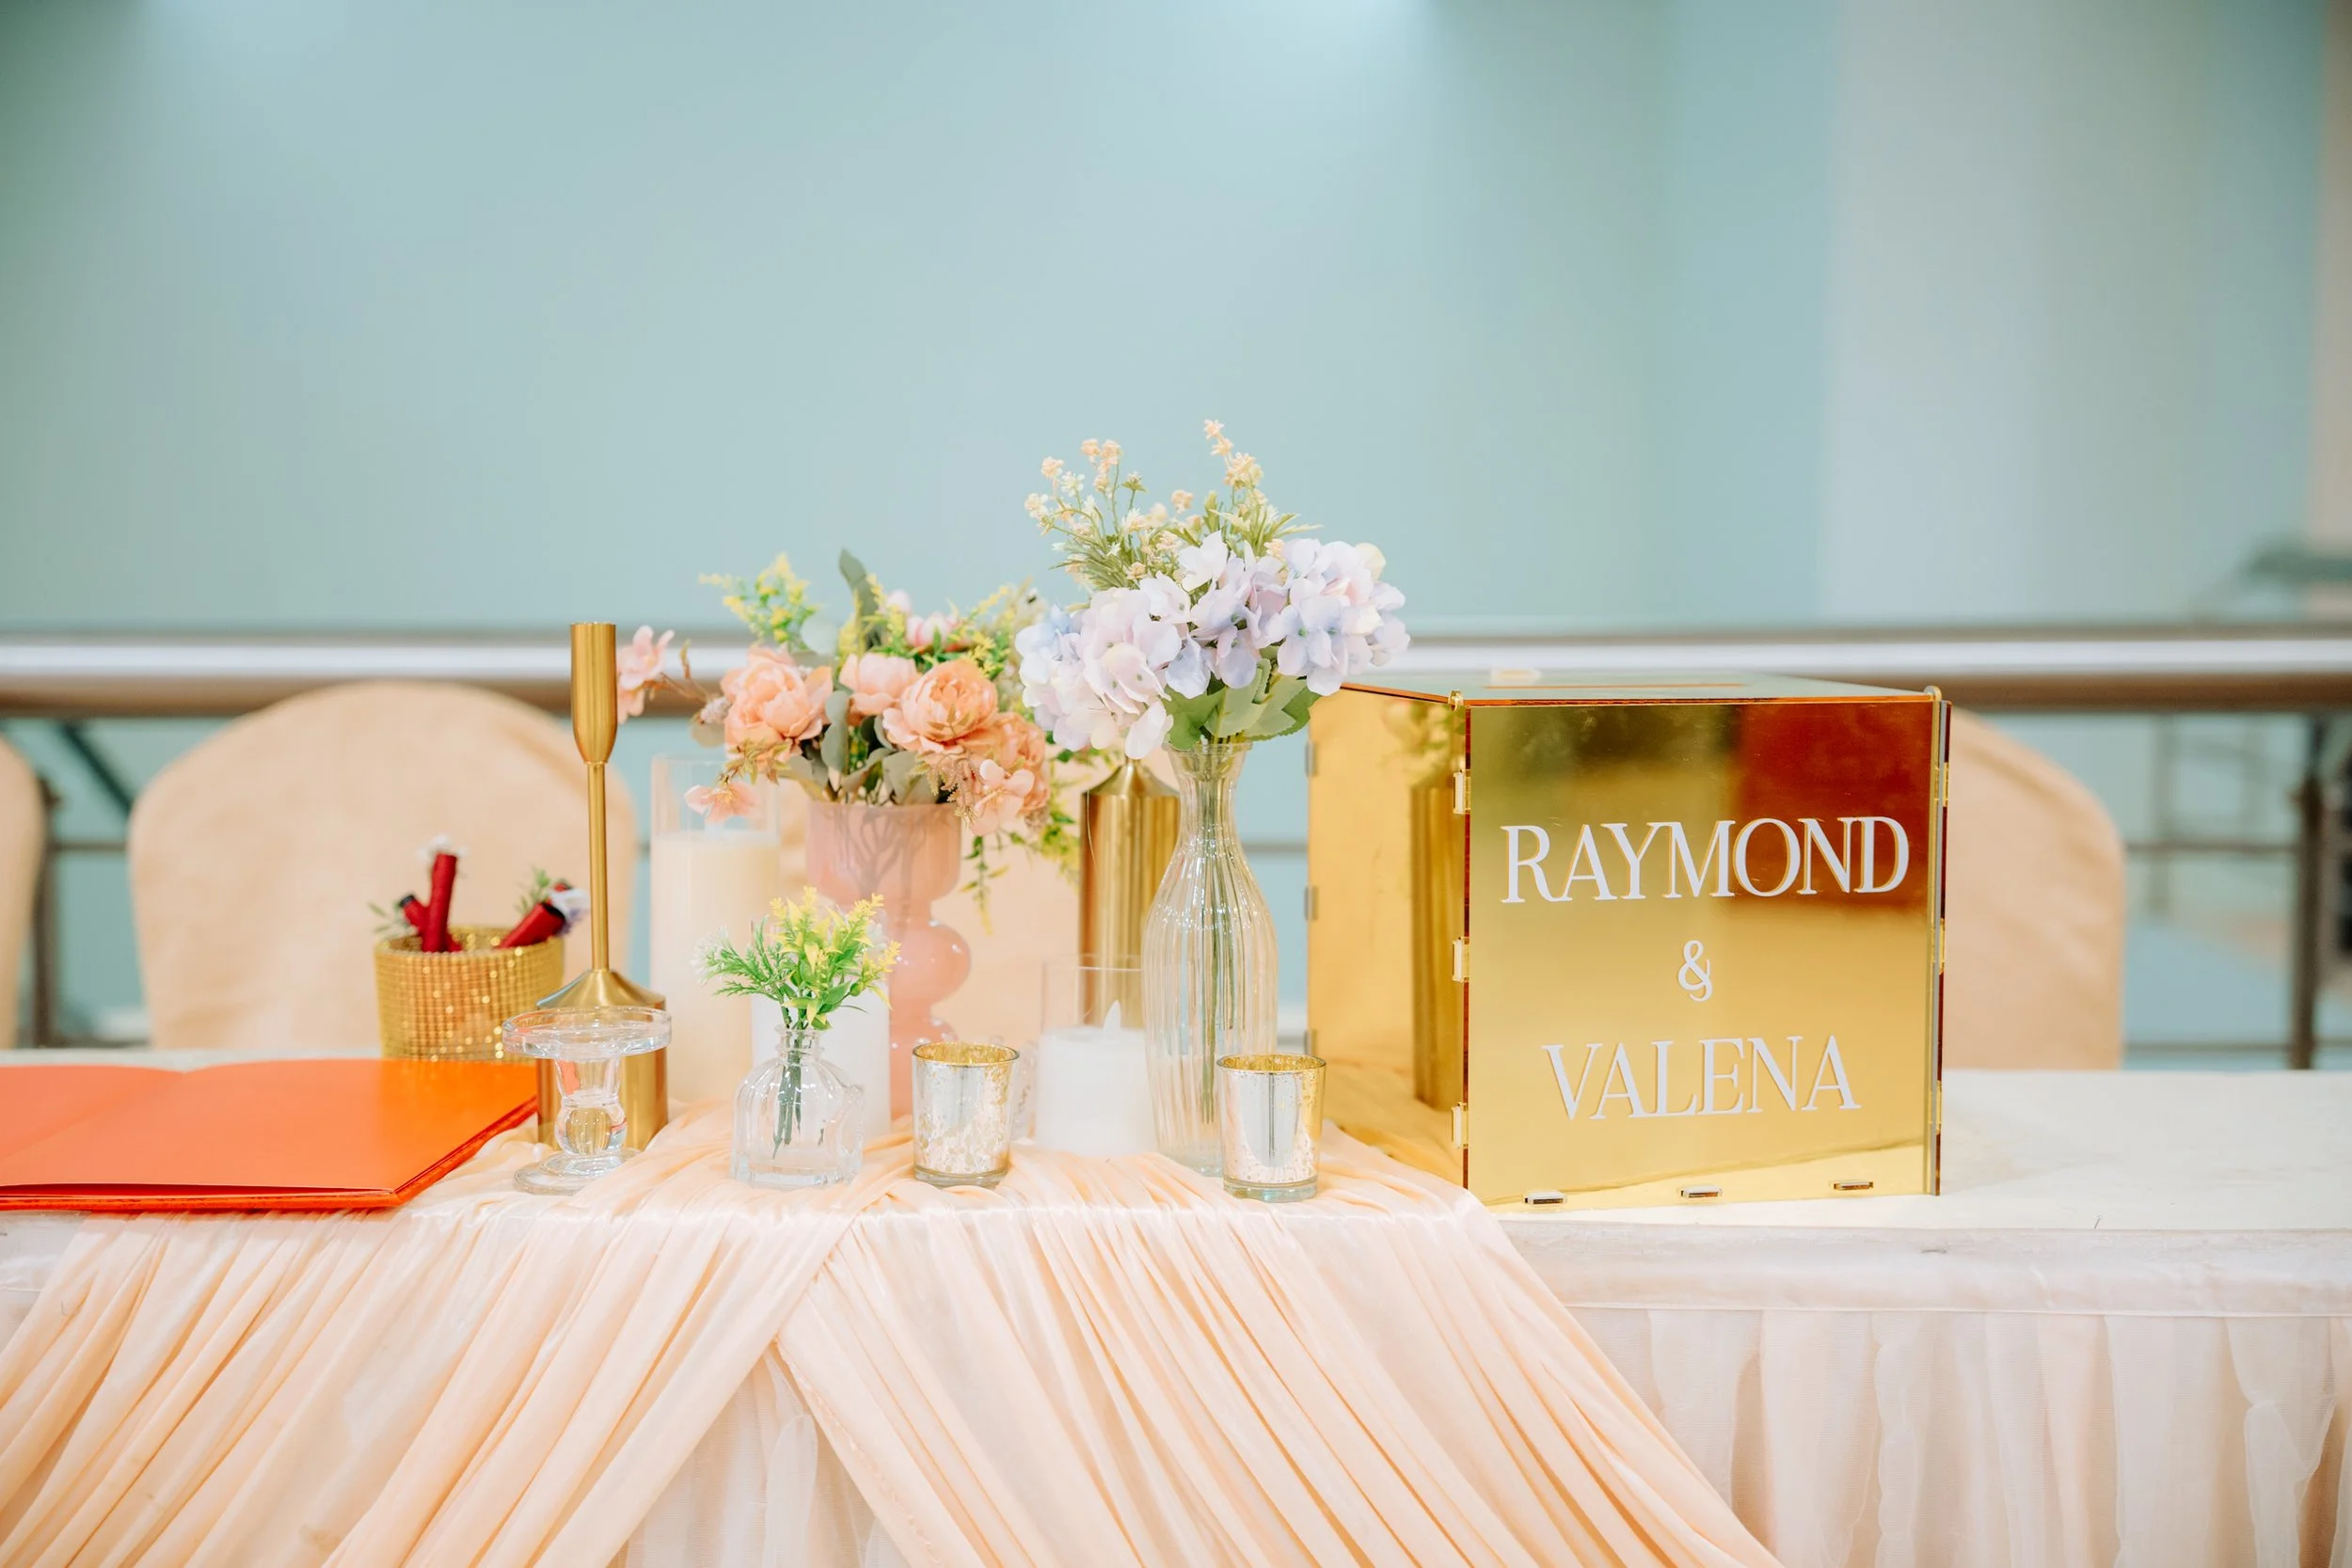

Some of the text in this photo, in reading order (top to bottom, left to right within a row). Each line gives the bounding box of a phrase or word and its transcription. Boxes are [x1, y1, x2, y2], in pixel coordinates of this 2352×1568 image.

[1500, 816, 1910, 903] RAYMOND
[1677, 940, 1712, 1002] &
[1541, 1035, 1862, 1120] VALENA
